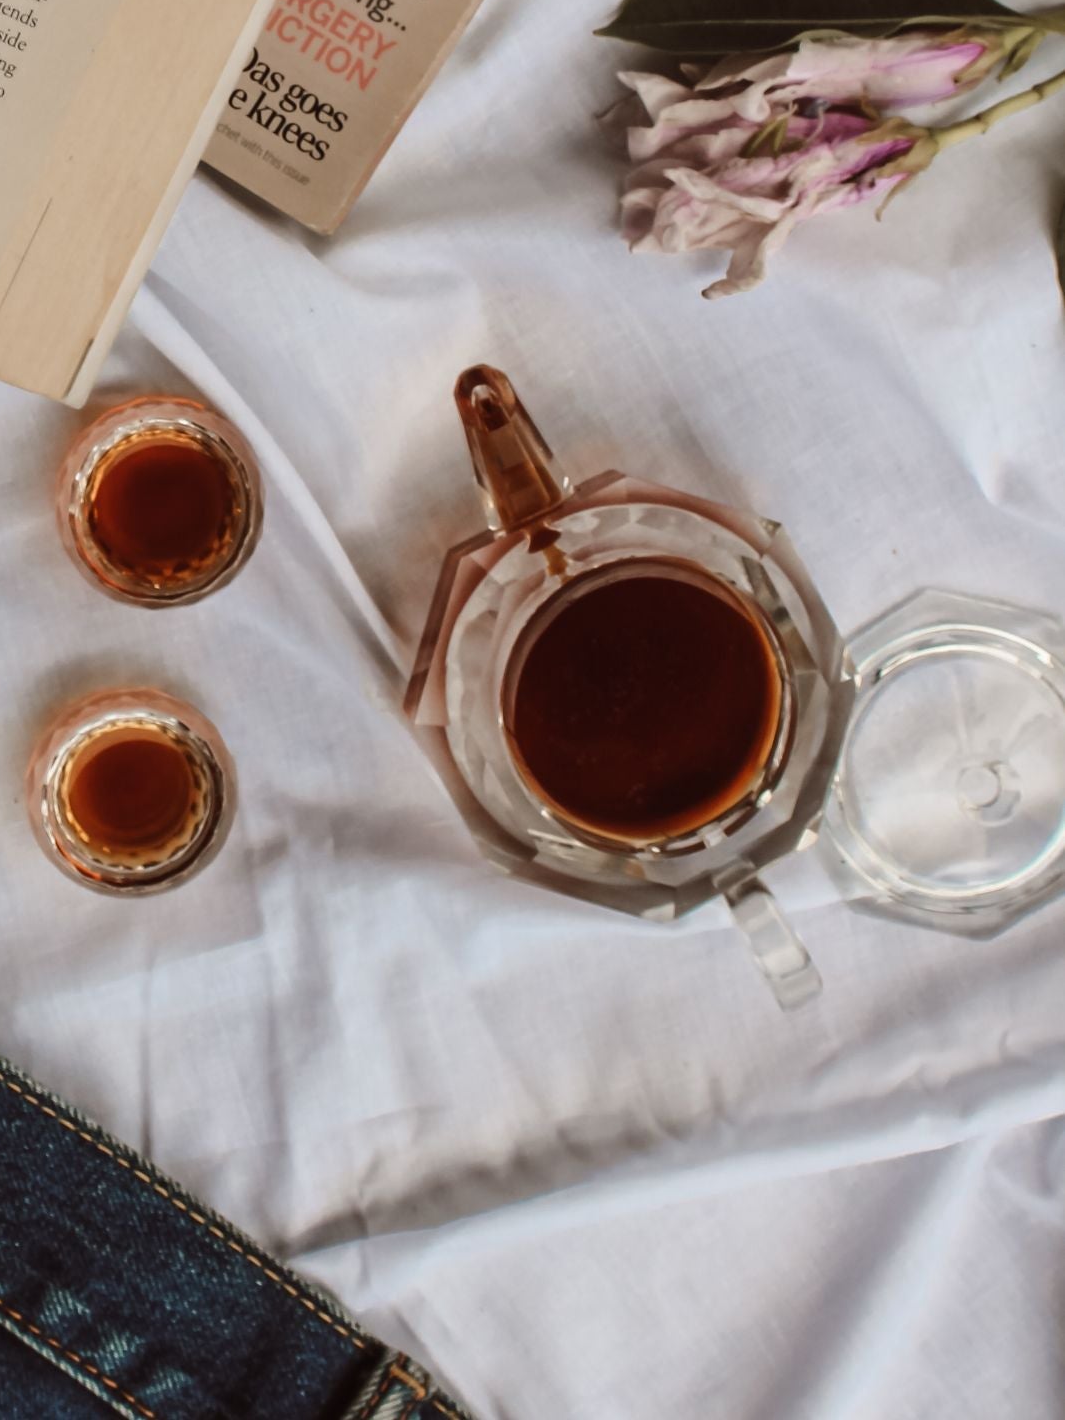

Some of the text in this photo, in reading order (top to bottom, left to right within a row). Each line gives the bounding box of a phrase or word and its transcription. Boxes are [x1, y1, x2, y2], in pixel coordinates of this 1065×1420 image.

[264, 7, 378, 91] ICTION
[245, 90, 330, 161] knees
[278, 84, 348, 132] goes
